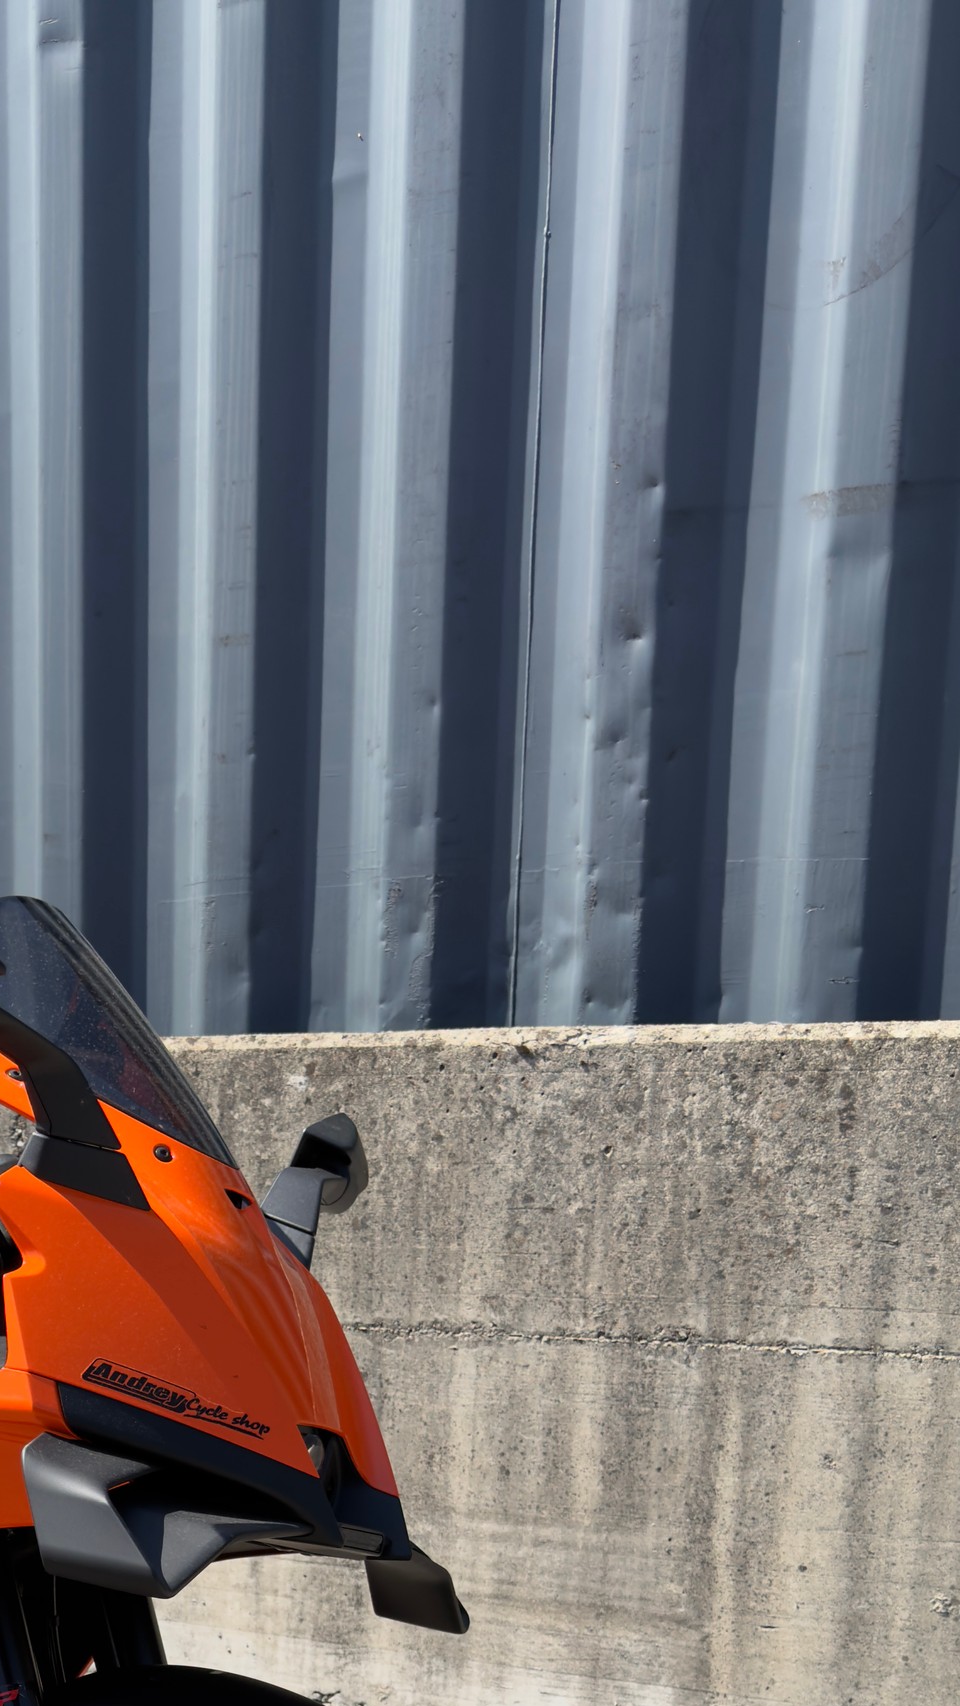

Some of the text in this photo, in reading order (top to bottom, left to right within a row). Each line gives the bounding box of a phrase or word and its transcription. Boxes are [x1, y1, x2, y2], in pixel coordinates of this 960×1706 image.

[93, 1362, 271, 1435] Andrey Cycle shop
